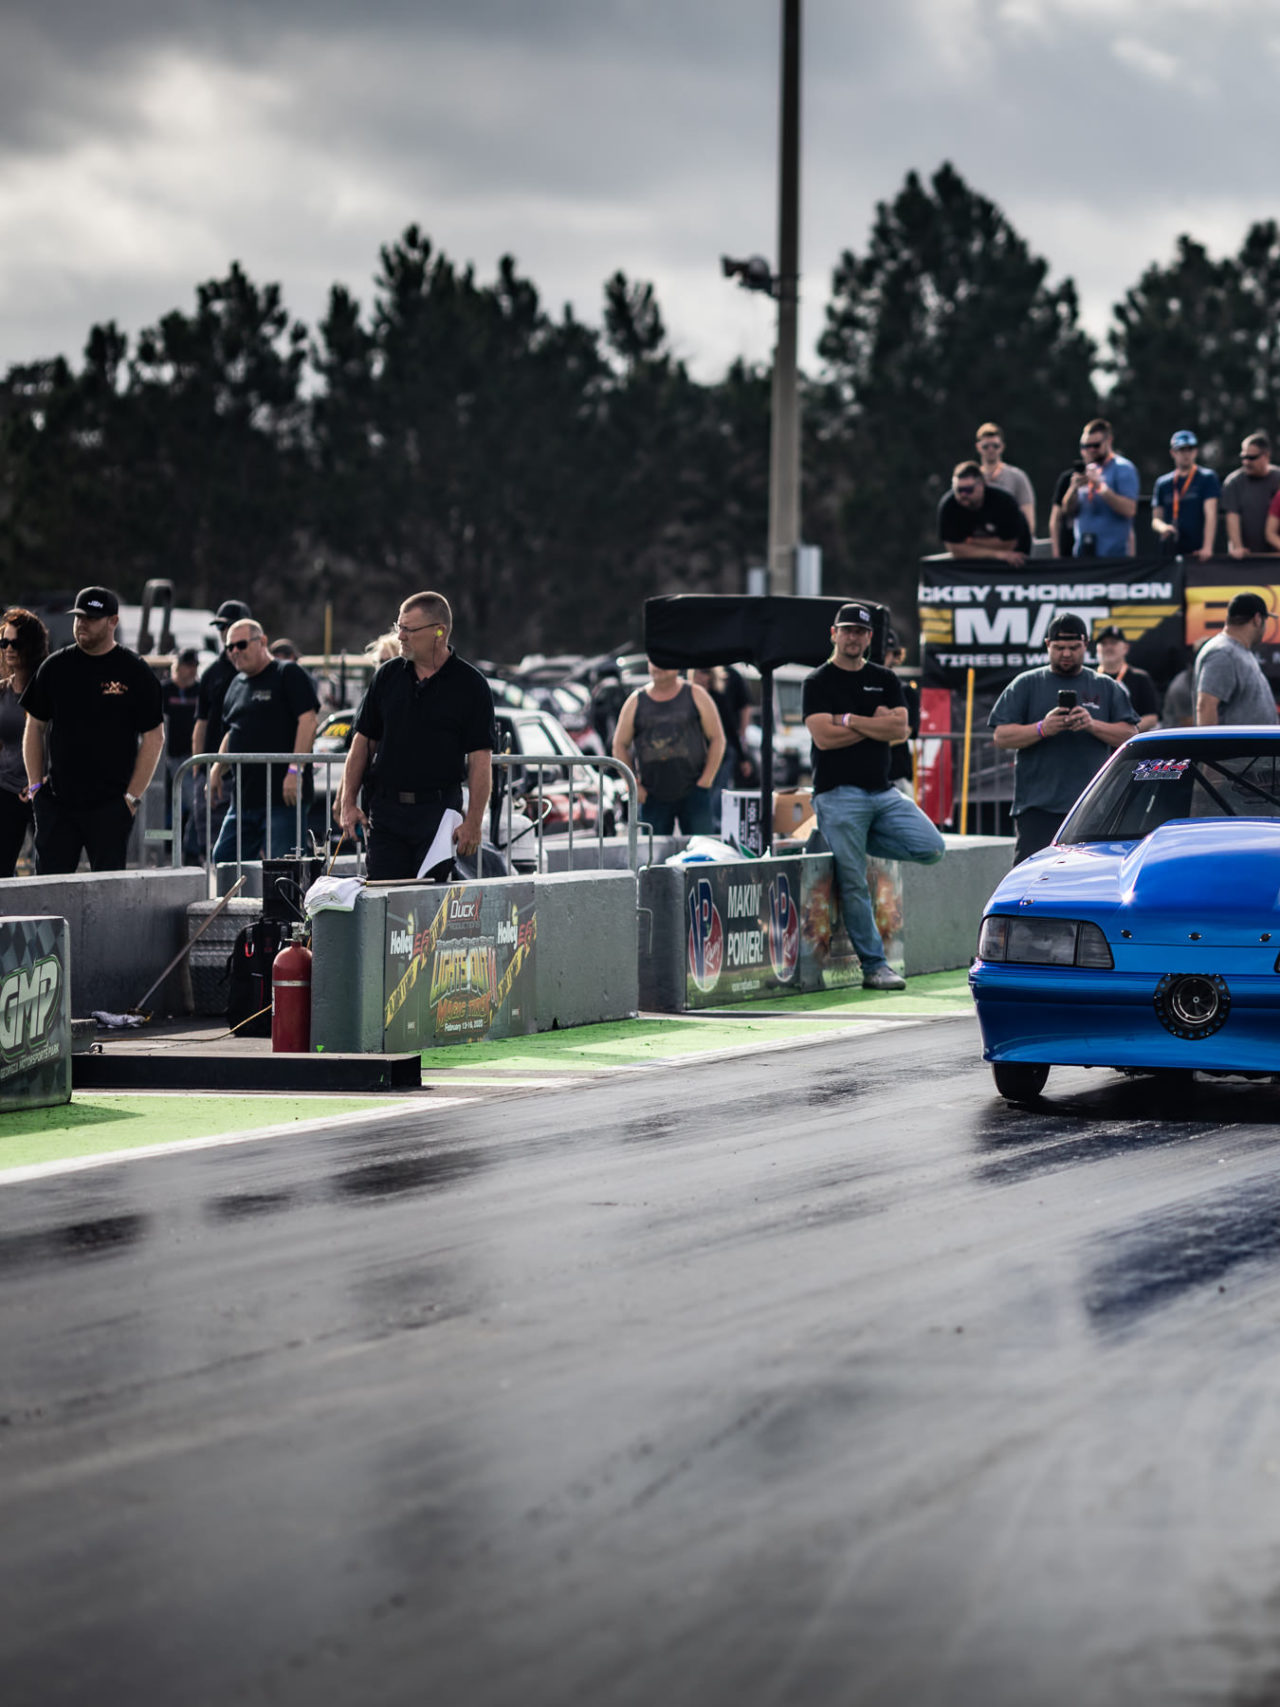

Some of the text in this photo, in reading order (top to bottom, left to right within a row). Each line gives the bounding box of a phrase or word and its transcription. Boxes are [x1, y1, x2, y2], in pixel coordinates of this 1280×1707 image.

[995, 583, 1172, 601] THOMPSON
[936, 653, 1004, 667] TIRES
[727, 883, 762, 919] MAKIN'
[390, 930, 414, 961] Holley
[497, 920, 519, 950] Holley
[726, 929, 764, 966] POWER!
[430, 948, 468, 1004] LIGHTS
[468, 945, 490, 993] OUT
[0, 961, 58, 1049] GMP
[444, 1021, 462, 1032] February
